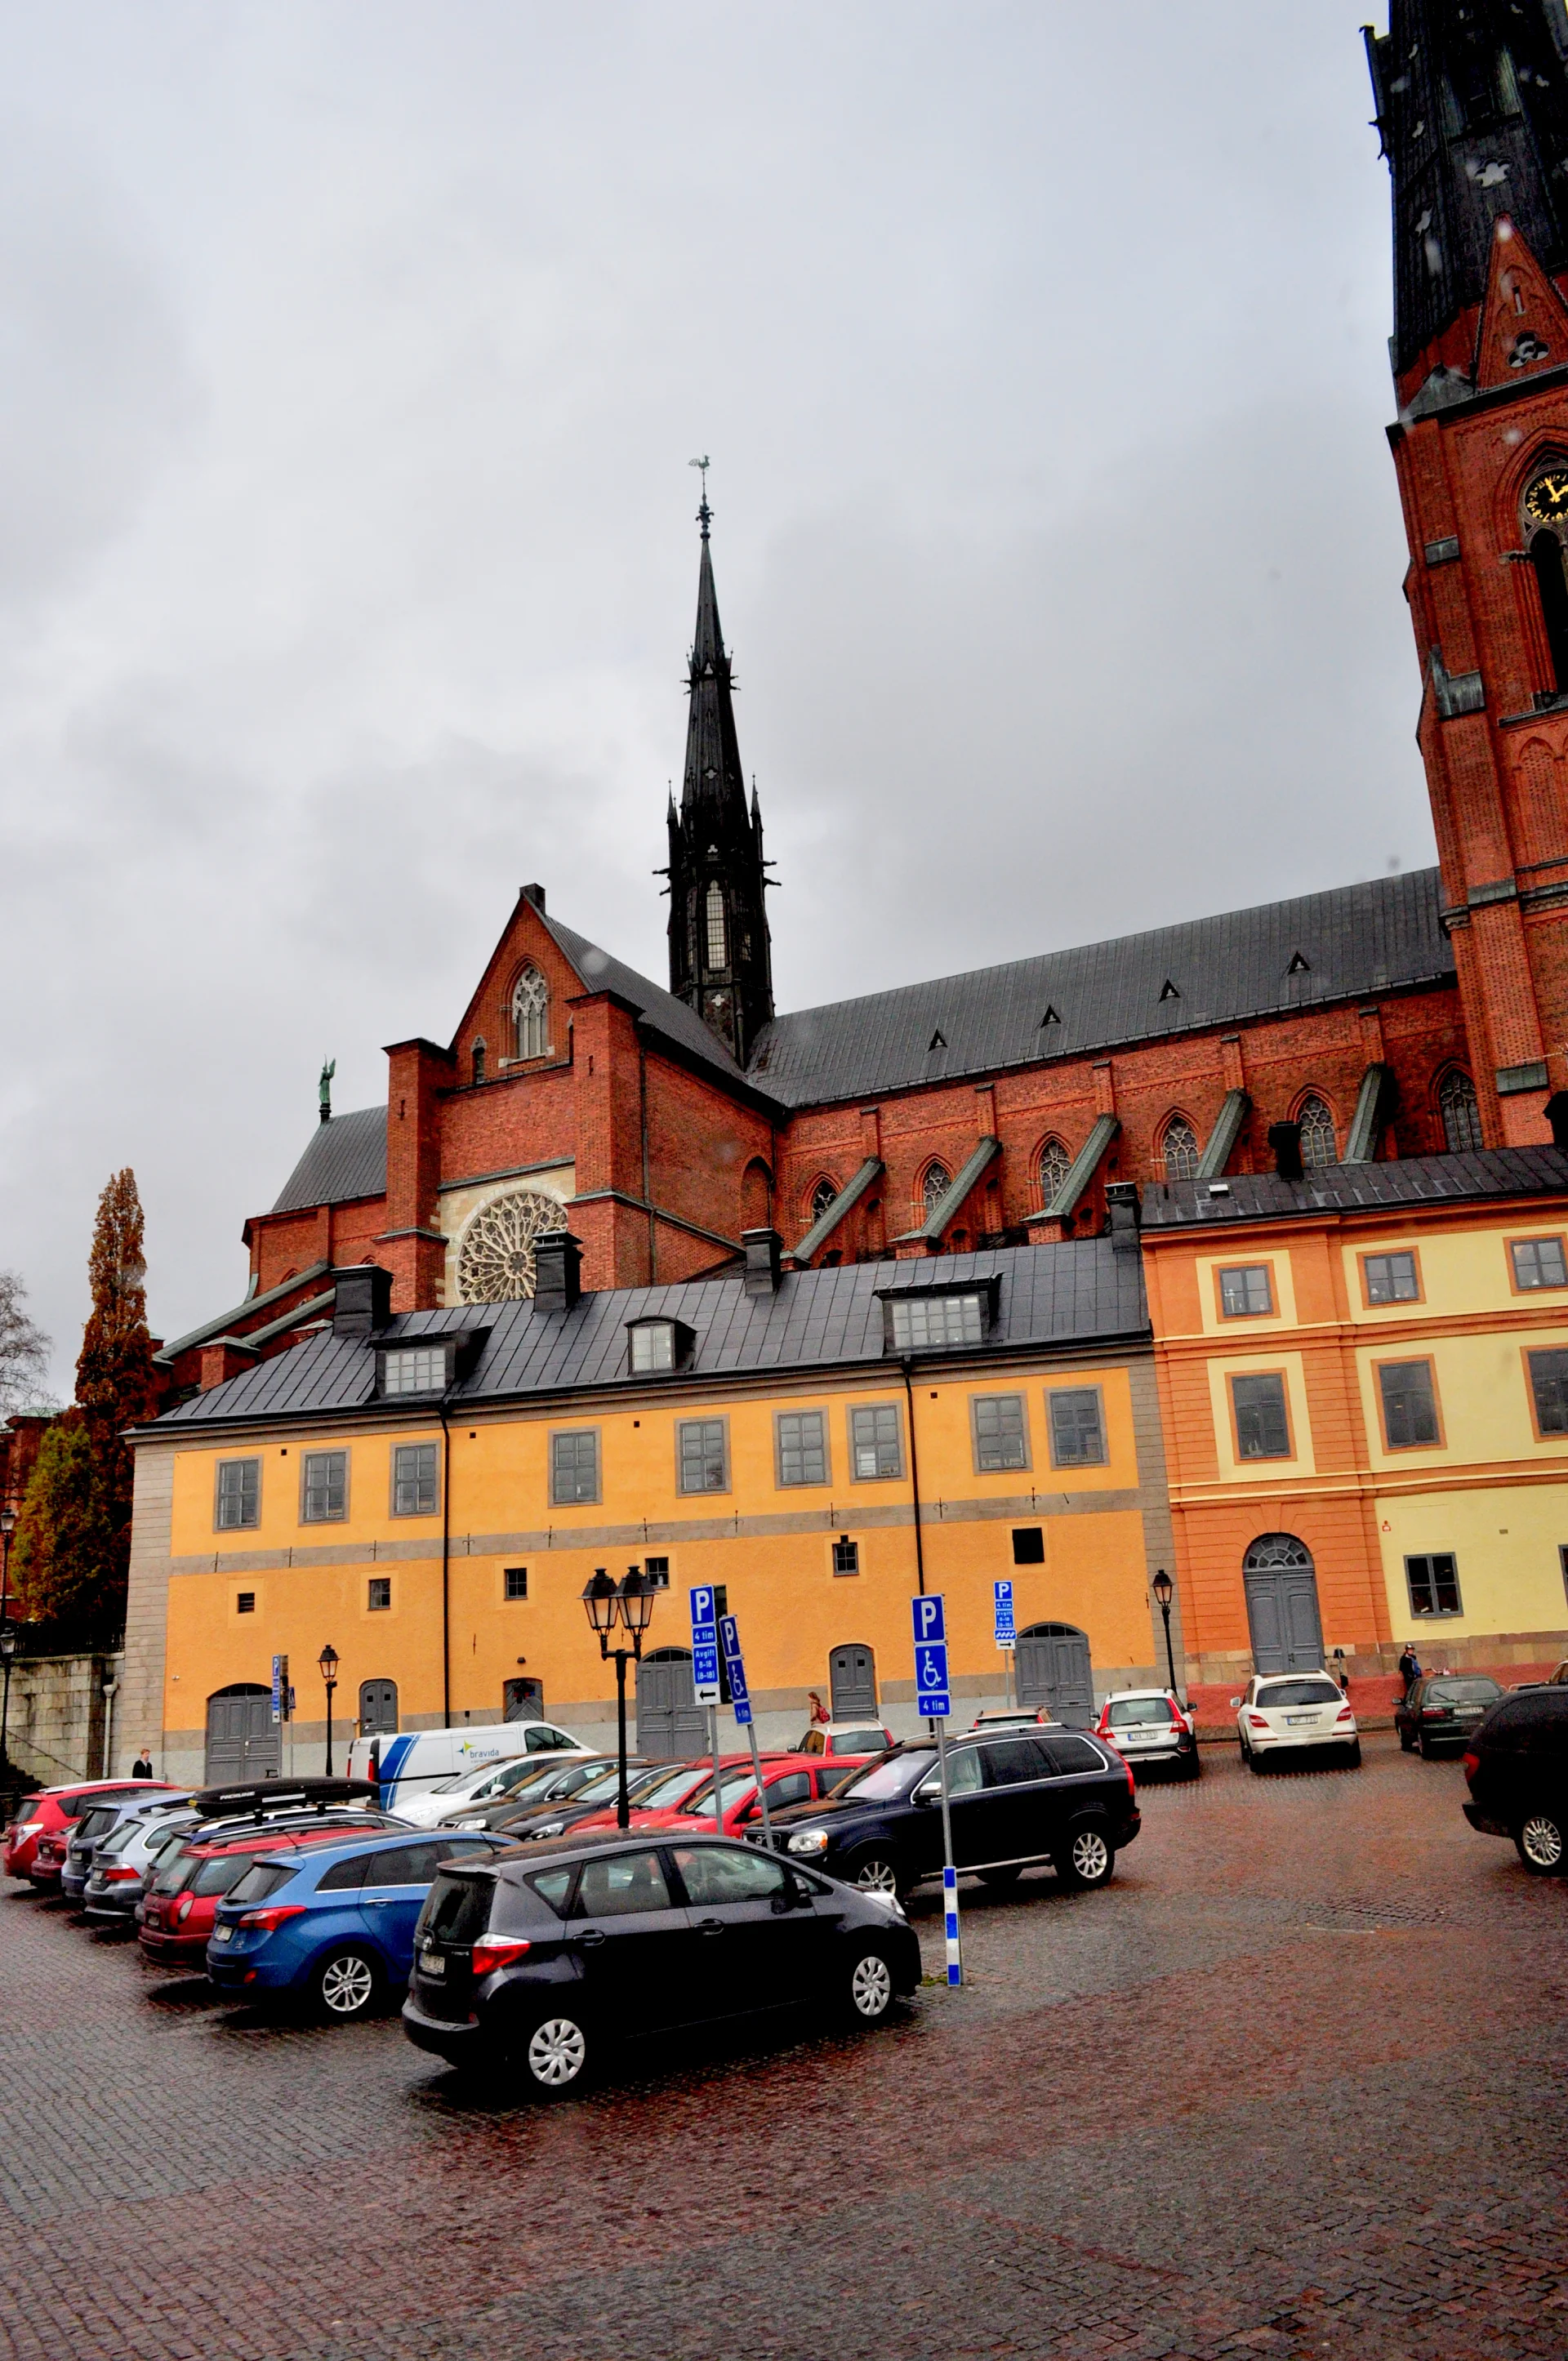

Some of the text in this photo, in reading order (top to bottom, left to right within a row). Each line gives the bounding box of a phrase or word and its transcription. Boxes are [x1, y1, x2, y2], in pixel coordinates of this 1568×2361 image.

[998, 1583, 1009, 1598] P
[695, 1590, 710, 1622] P
[920, 1601, 937, 1638] P
[694, 1630, 714, 1641] 4 tim
[724, 1621, 734, 1654] P
[695, 1649, 715, 1659] Avgift
[273, 1657, 278, 1675] P
[698, 1660, 712, 1668] 8-18
[697, 1670, 715, 1681] (8-18)
[923, 1699, 945, 1711] 4 tim
[470, 1748, 500, 1758] bravida
